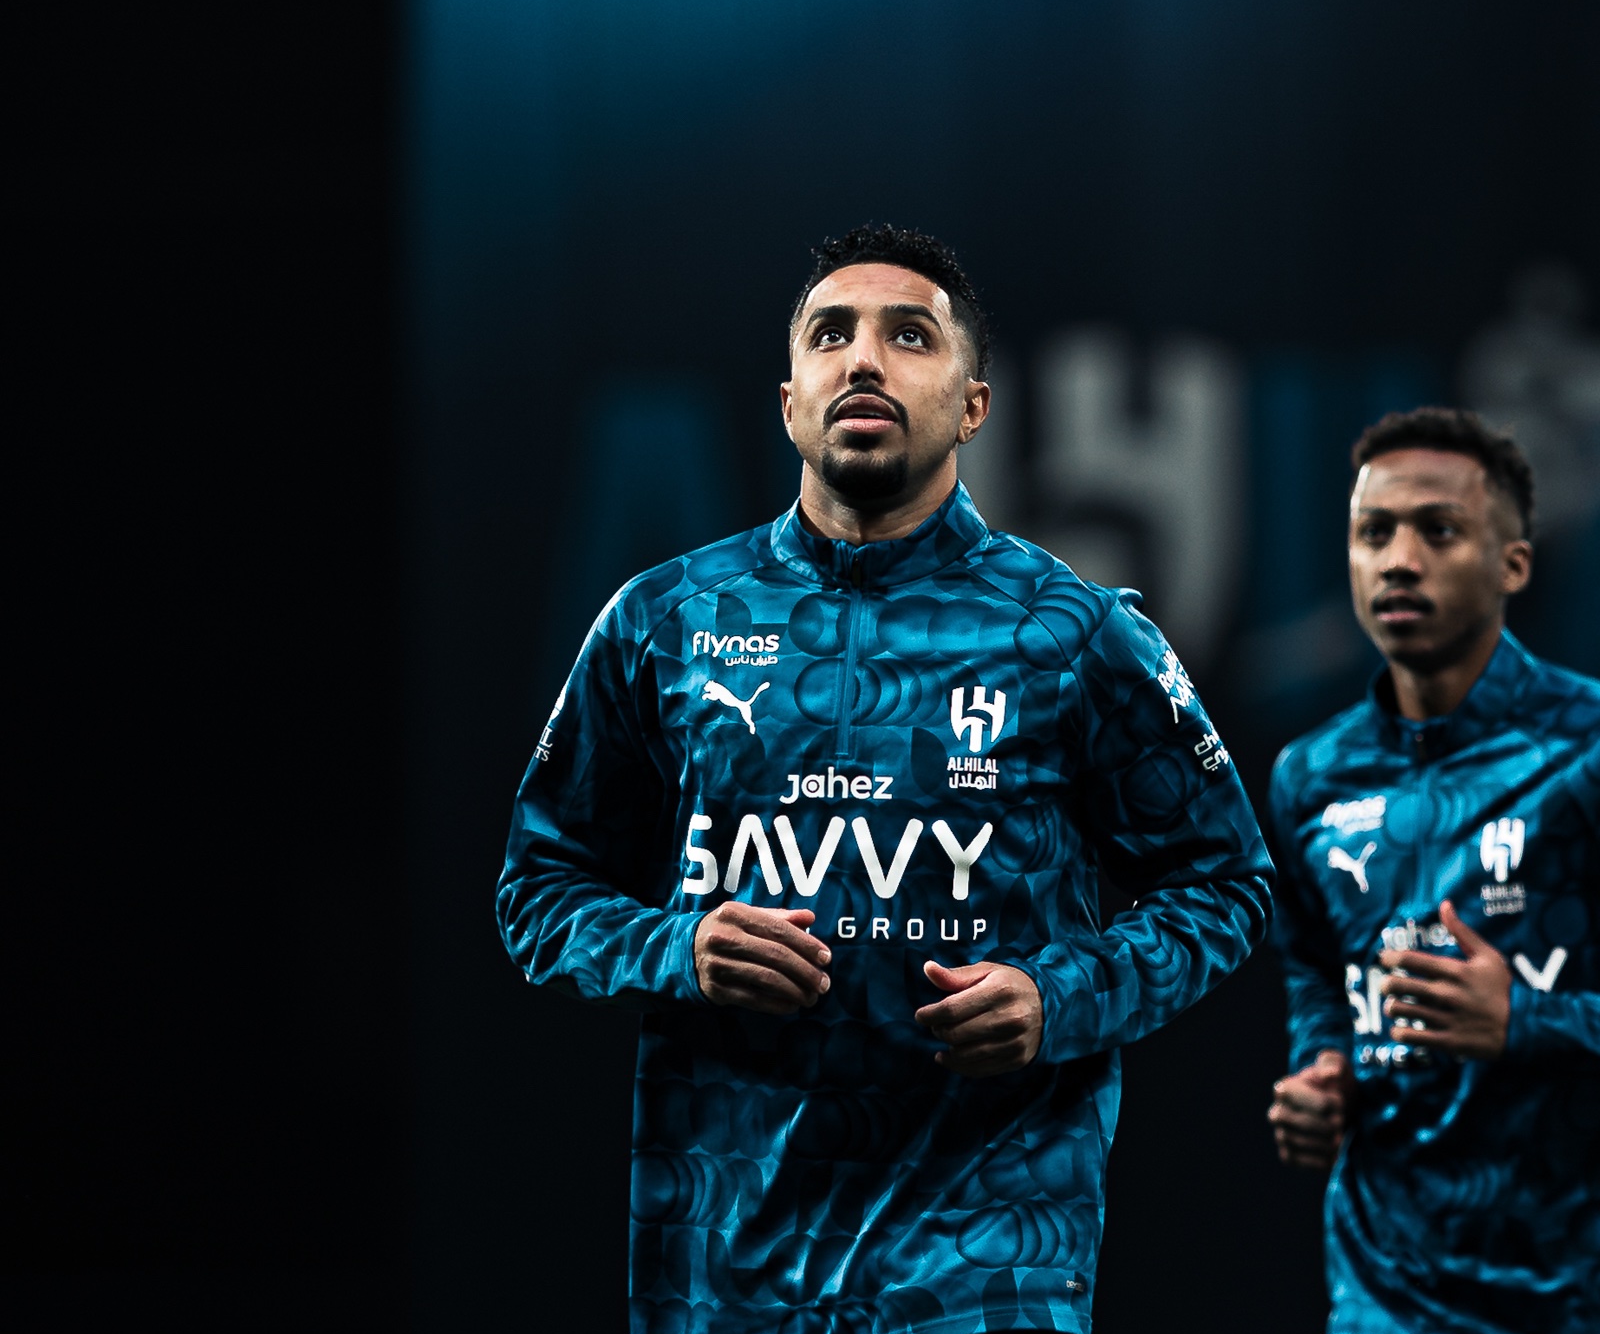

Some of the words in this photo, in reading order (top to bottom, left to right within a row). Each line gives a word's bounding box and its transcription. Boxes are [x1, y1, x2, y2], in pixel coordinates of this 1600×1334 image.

[692, 630, 780, 658] flynas
[948, 772, 997, 790] الهلال
[681, 813, 994, 901] SAVVY
[837, 916, 987, 941] GROUP
